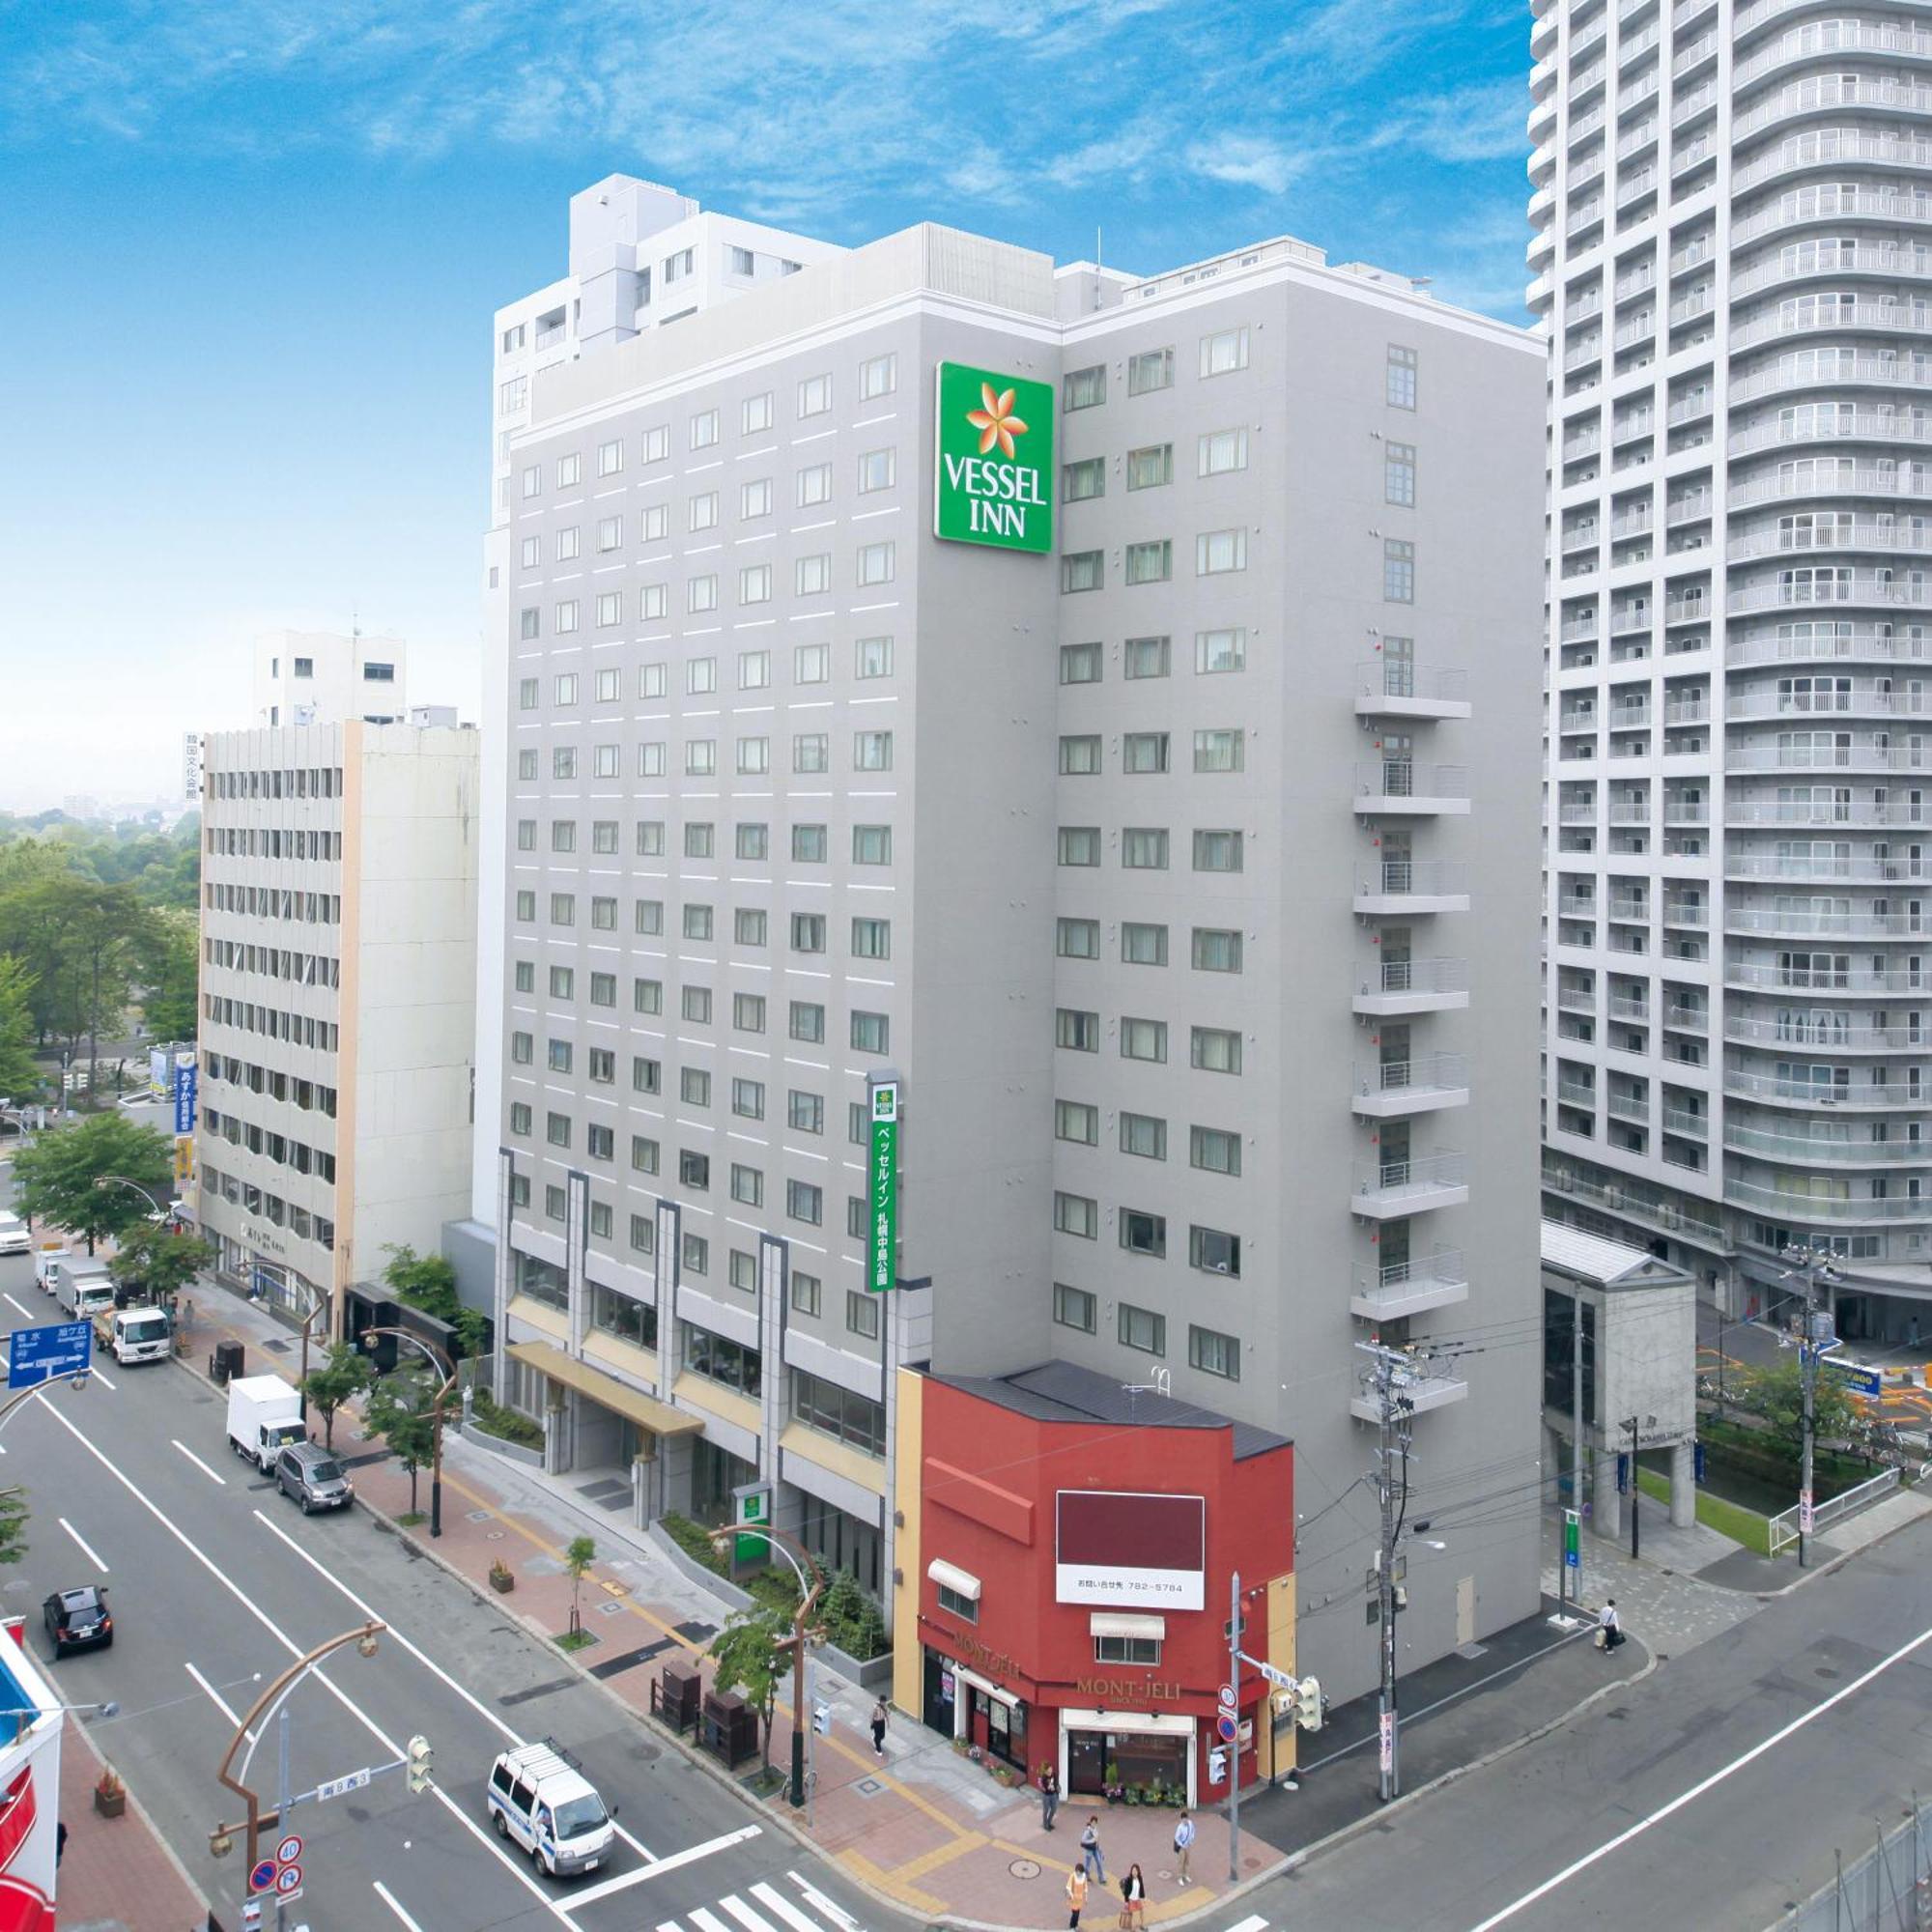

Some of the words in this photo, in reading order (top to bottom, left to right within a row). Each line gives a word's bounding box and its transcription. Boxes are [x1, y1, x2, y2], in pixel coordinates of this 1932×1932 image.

[944, 453, 1047, 505] VESSEL
[970, 498, 1026, 538] INN
[877, 1127, 890, 1208] ベッセルイン
[876, 1212, 889, 1286] 札幌中島公園
[1128, 1582, 1183, 1593] 782-5784
[283, 1842, 297, 1859] 40
